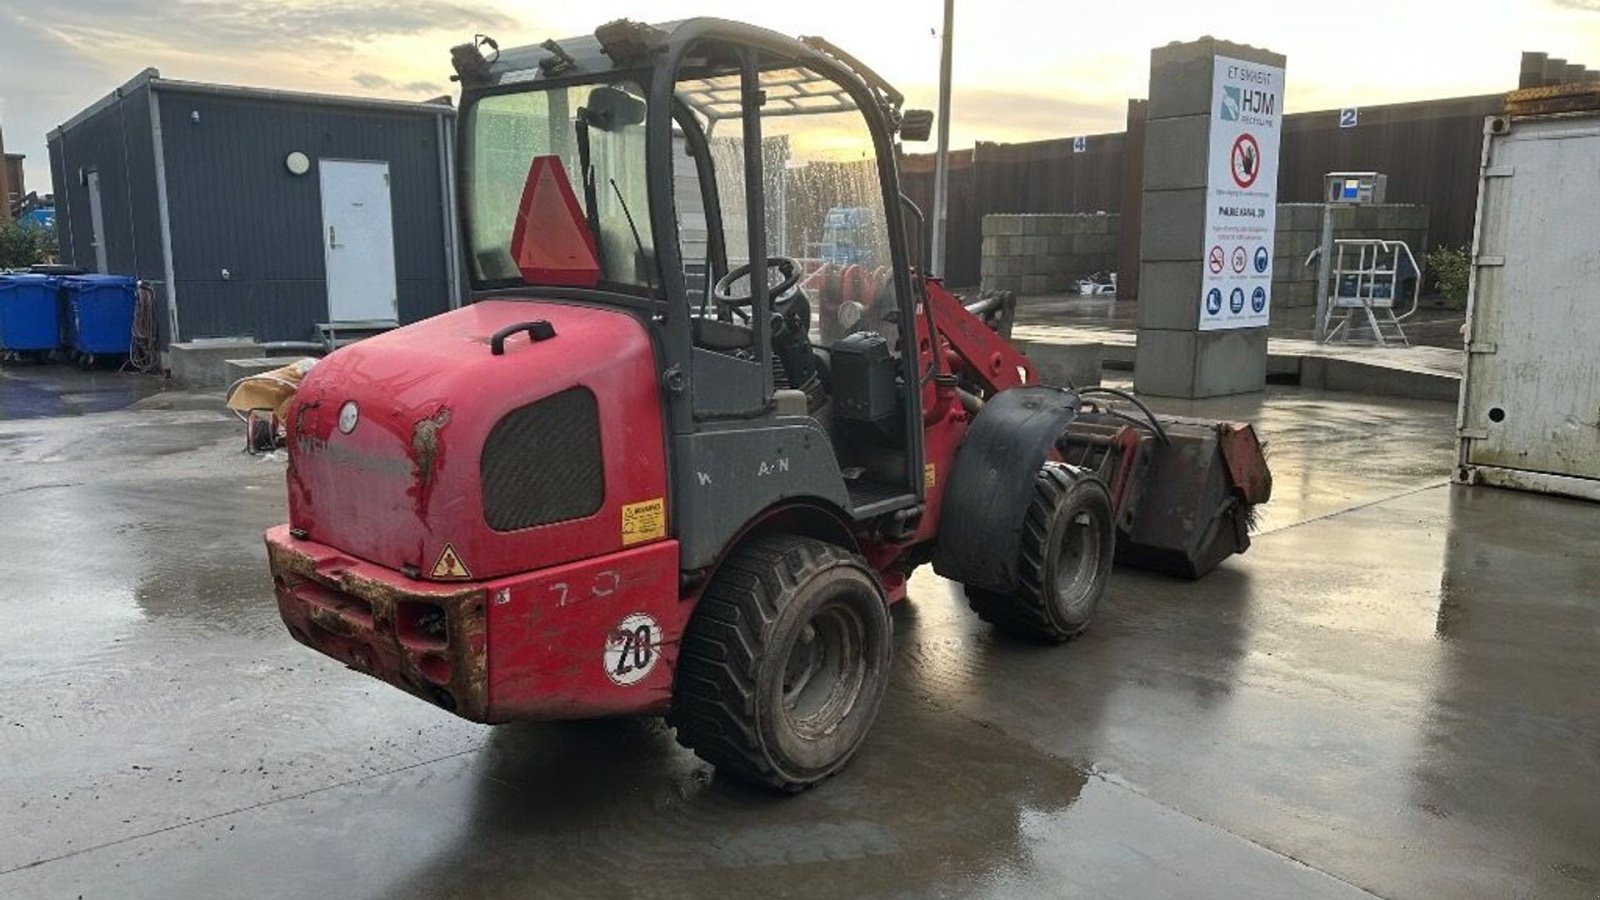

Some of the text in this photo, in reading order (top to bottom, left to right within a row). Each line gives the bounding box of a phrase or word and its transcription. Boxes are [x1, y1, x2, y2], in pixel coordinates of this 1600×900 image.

[1242, 88, 1275, 115] HJM
[1342, 109, 1355, 126] 2
[1075, 136, 1086, 151] 4
[613, 624, 653, 676] 20
